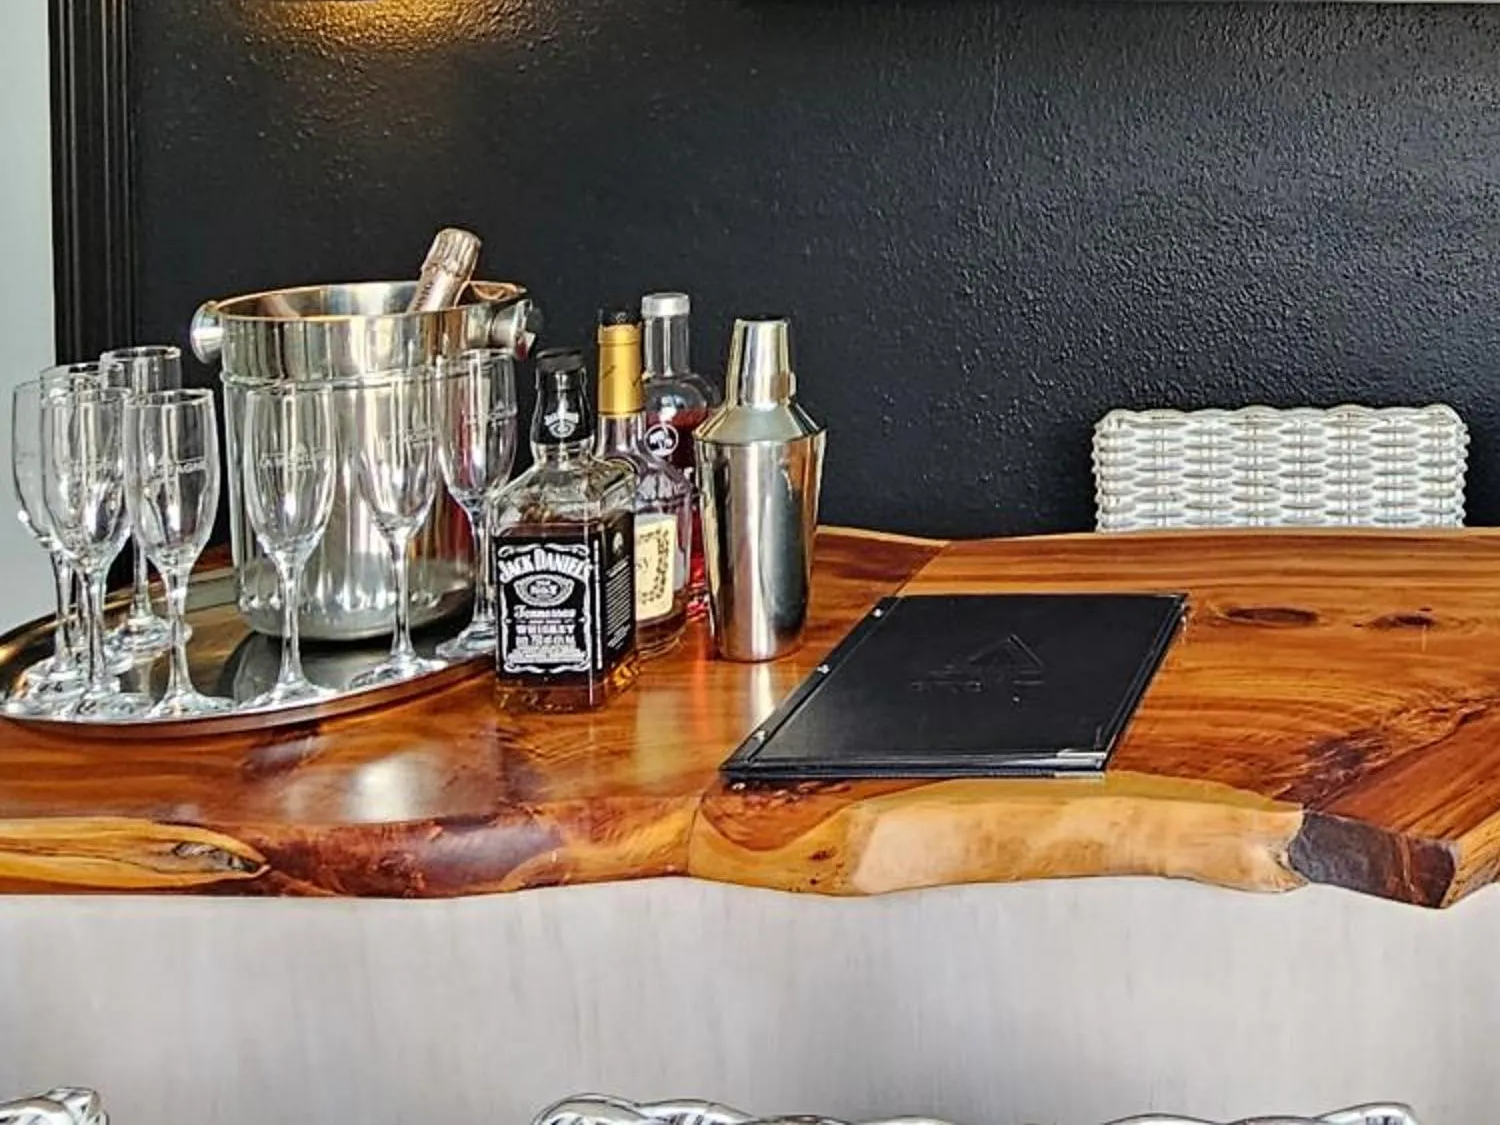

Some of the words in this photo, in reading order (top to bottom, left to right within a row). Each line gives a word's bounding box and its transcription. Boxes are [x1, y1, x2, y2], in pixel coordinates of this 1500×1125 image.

[497, 553, 536, 584] JACK
[533, 548, 593, 583] DANIEL'S
[515, 624, 575, 635] WHISKEY
